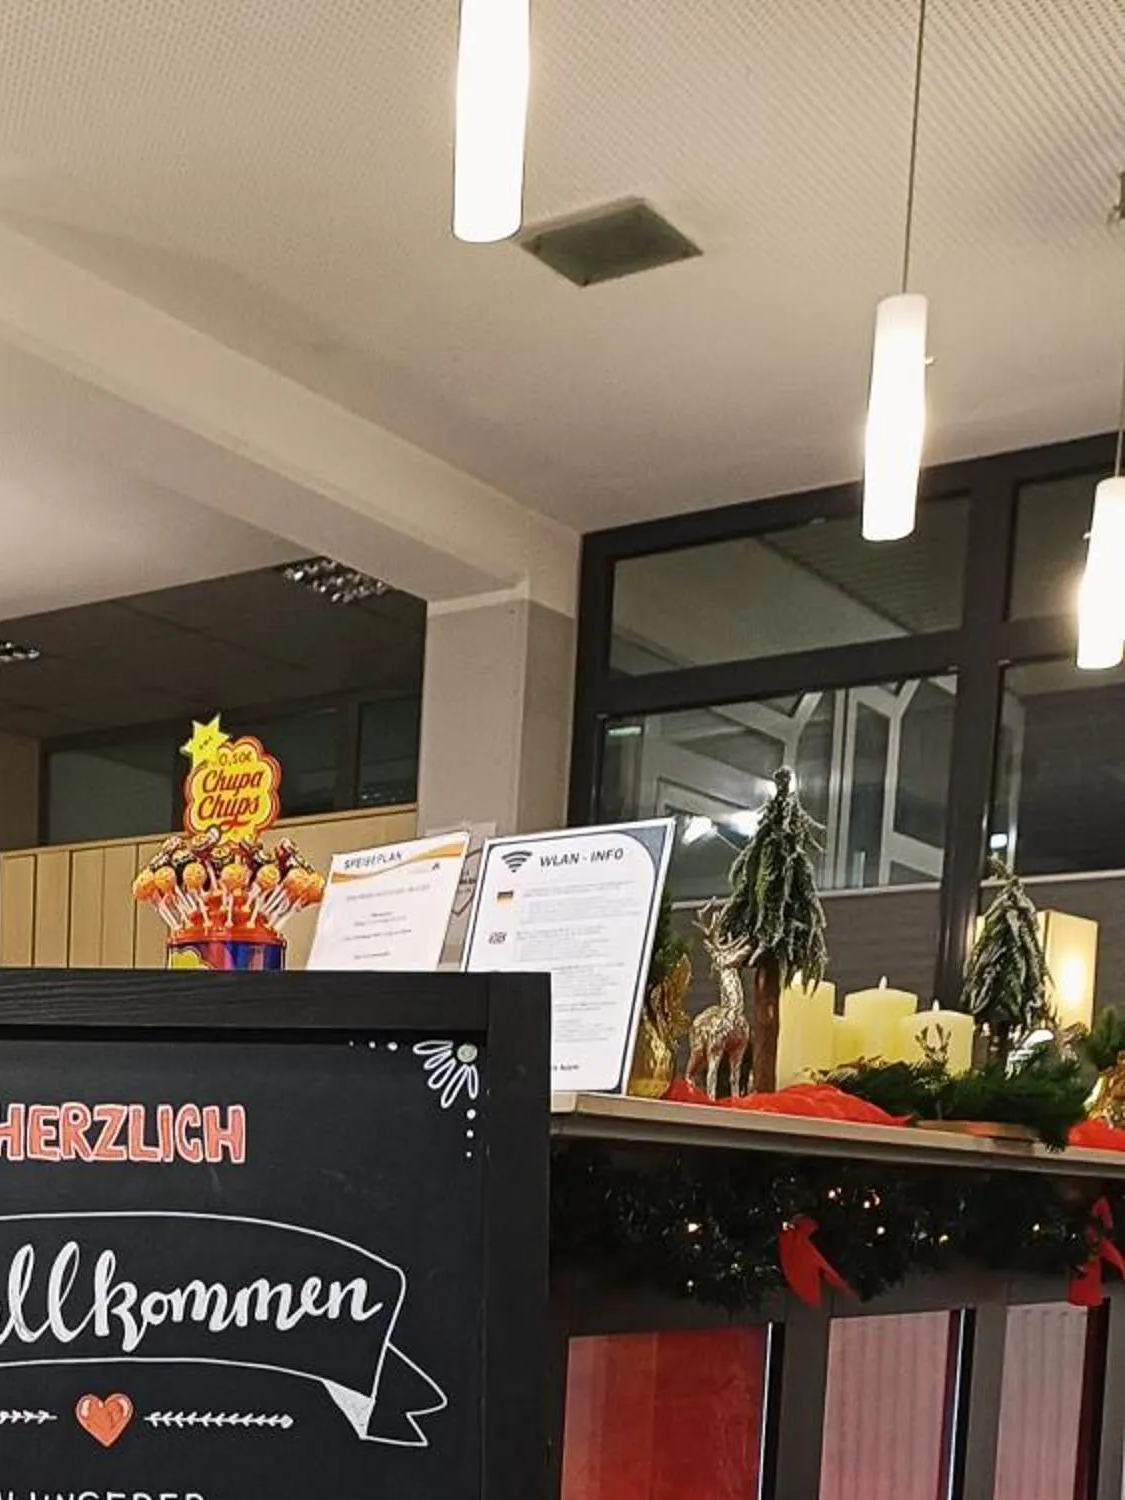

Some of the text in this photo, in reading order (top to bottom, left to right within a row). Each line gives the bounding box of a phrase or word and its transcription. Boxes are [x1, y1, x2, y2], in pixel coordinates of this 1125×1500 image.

[202, 769, 263, 796] Chupa
[198, 794, 260, 826] Chups
[539, 853, 580, 867] WLAN
[590, 847, 624, 863] INFO
